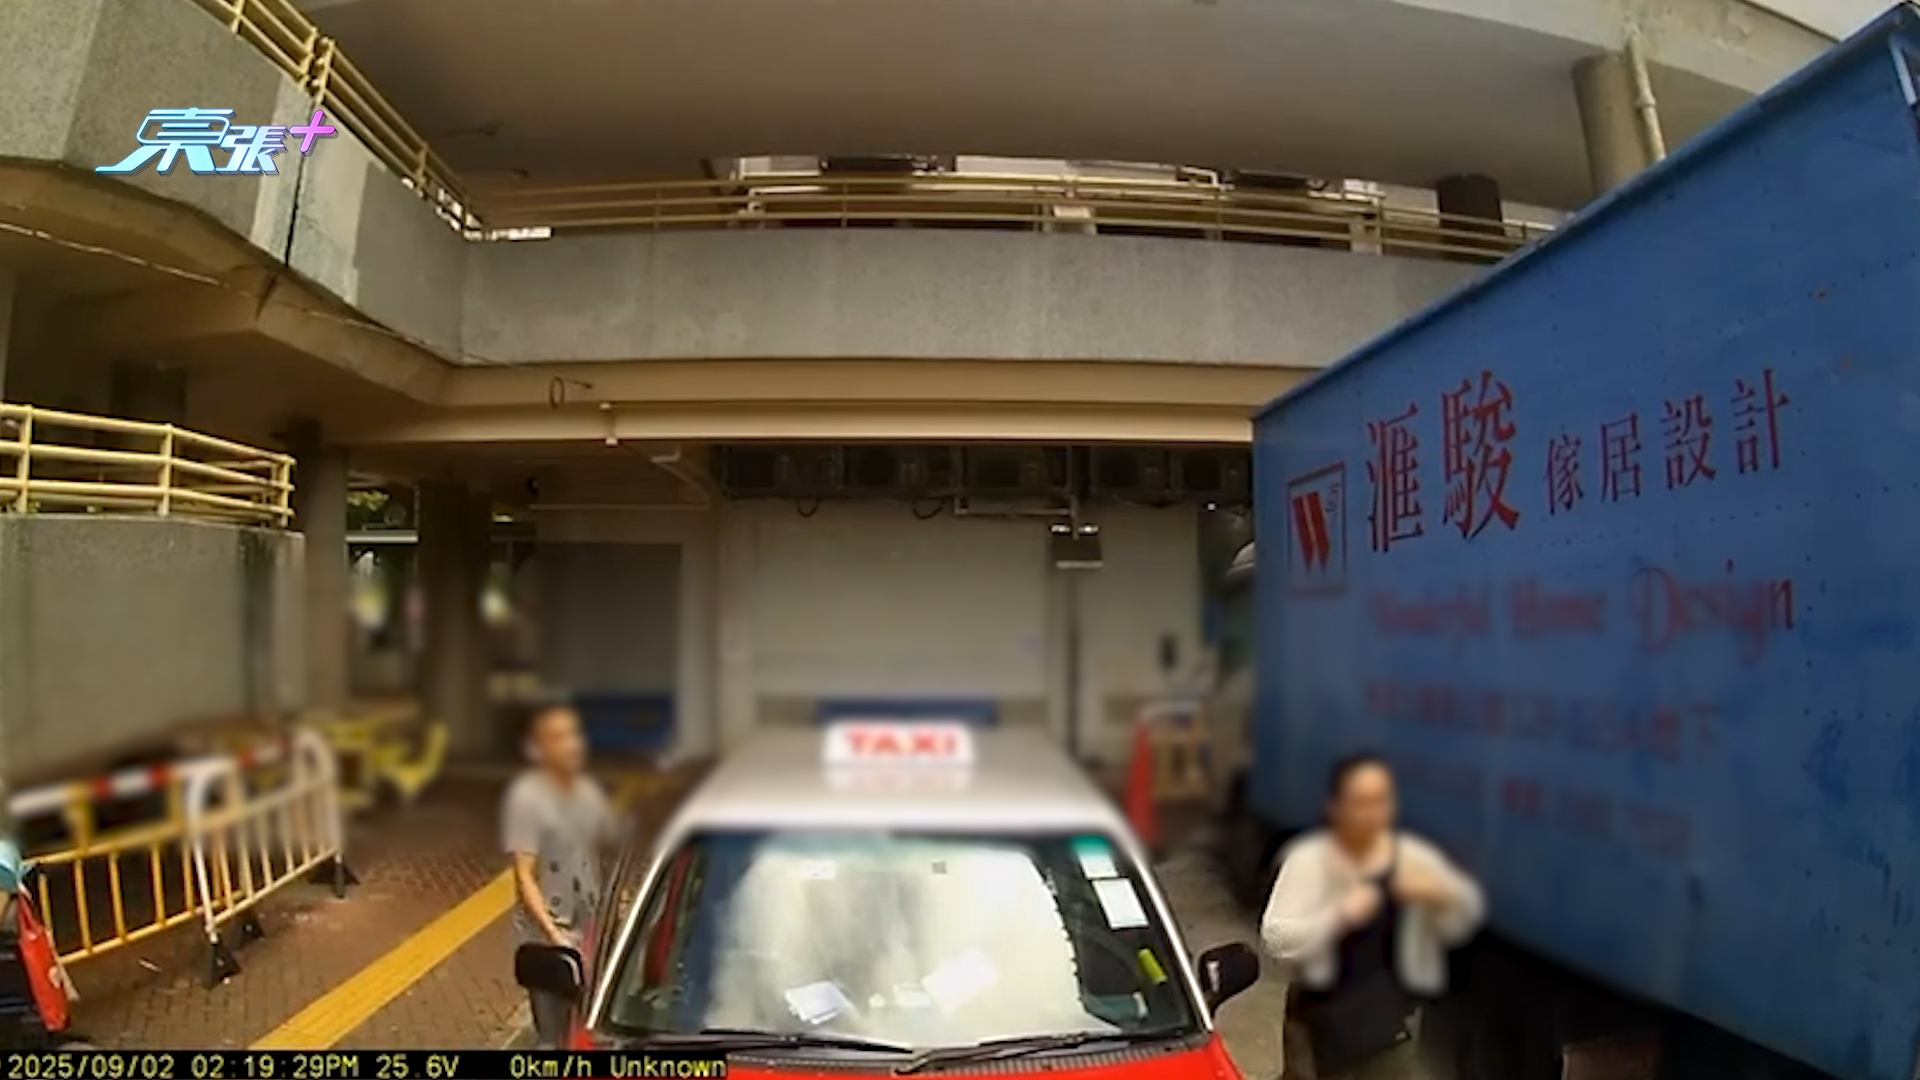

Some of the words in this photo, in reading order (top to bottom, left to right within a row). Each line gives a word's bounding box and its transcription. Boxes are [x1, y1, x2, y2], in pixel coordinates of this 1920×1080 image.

[1545, 369, 1790, 515] 傢居設計
[1634, 559, 1794, 666] Design
[845, 725, 958, 757] TAXI
